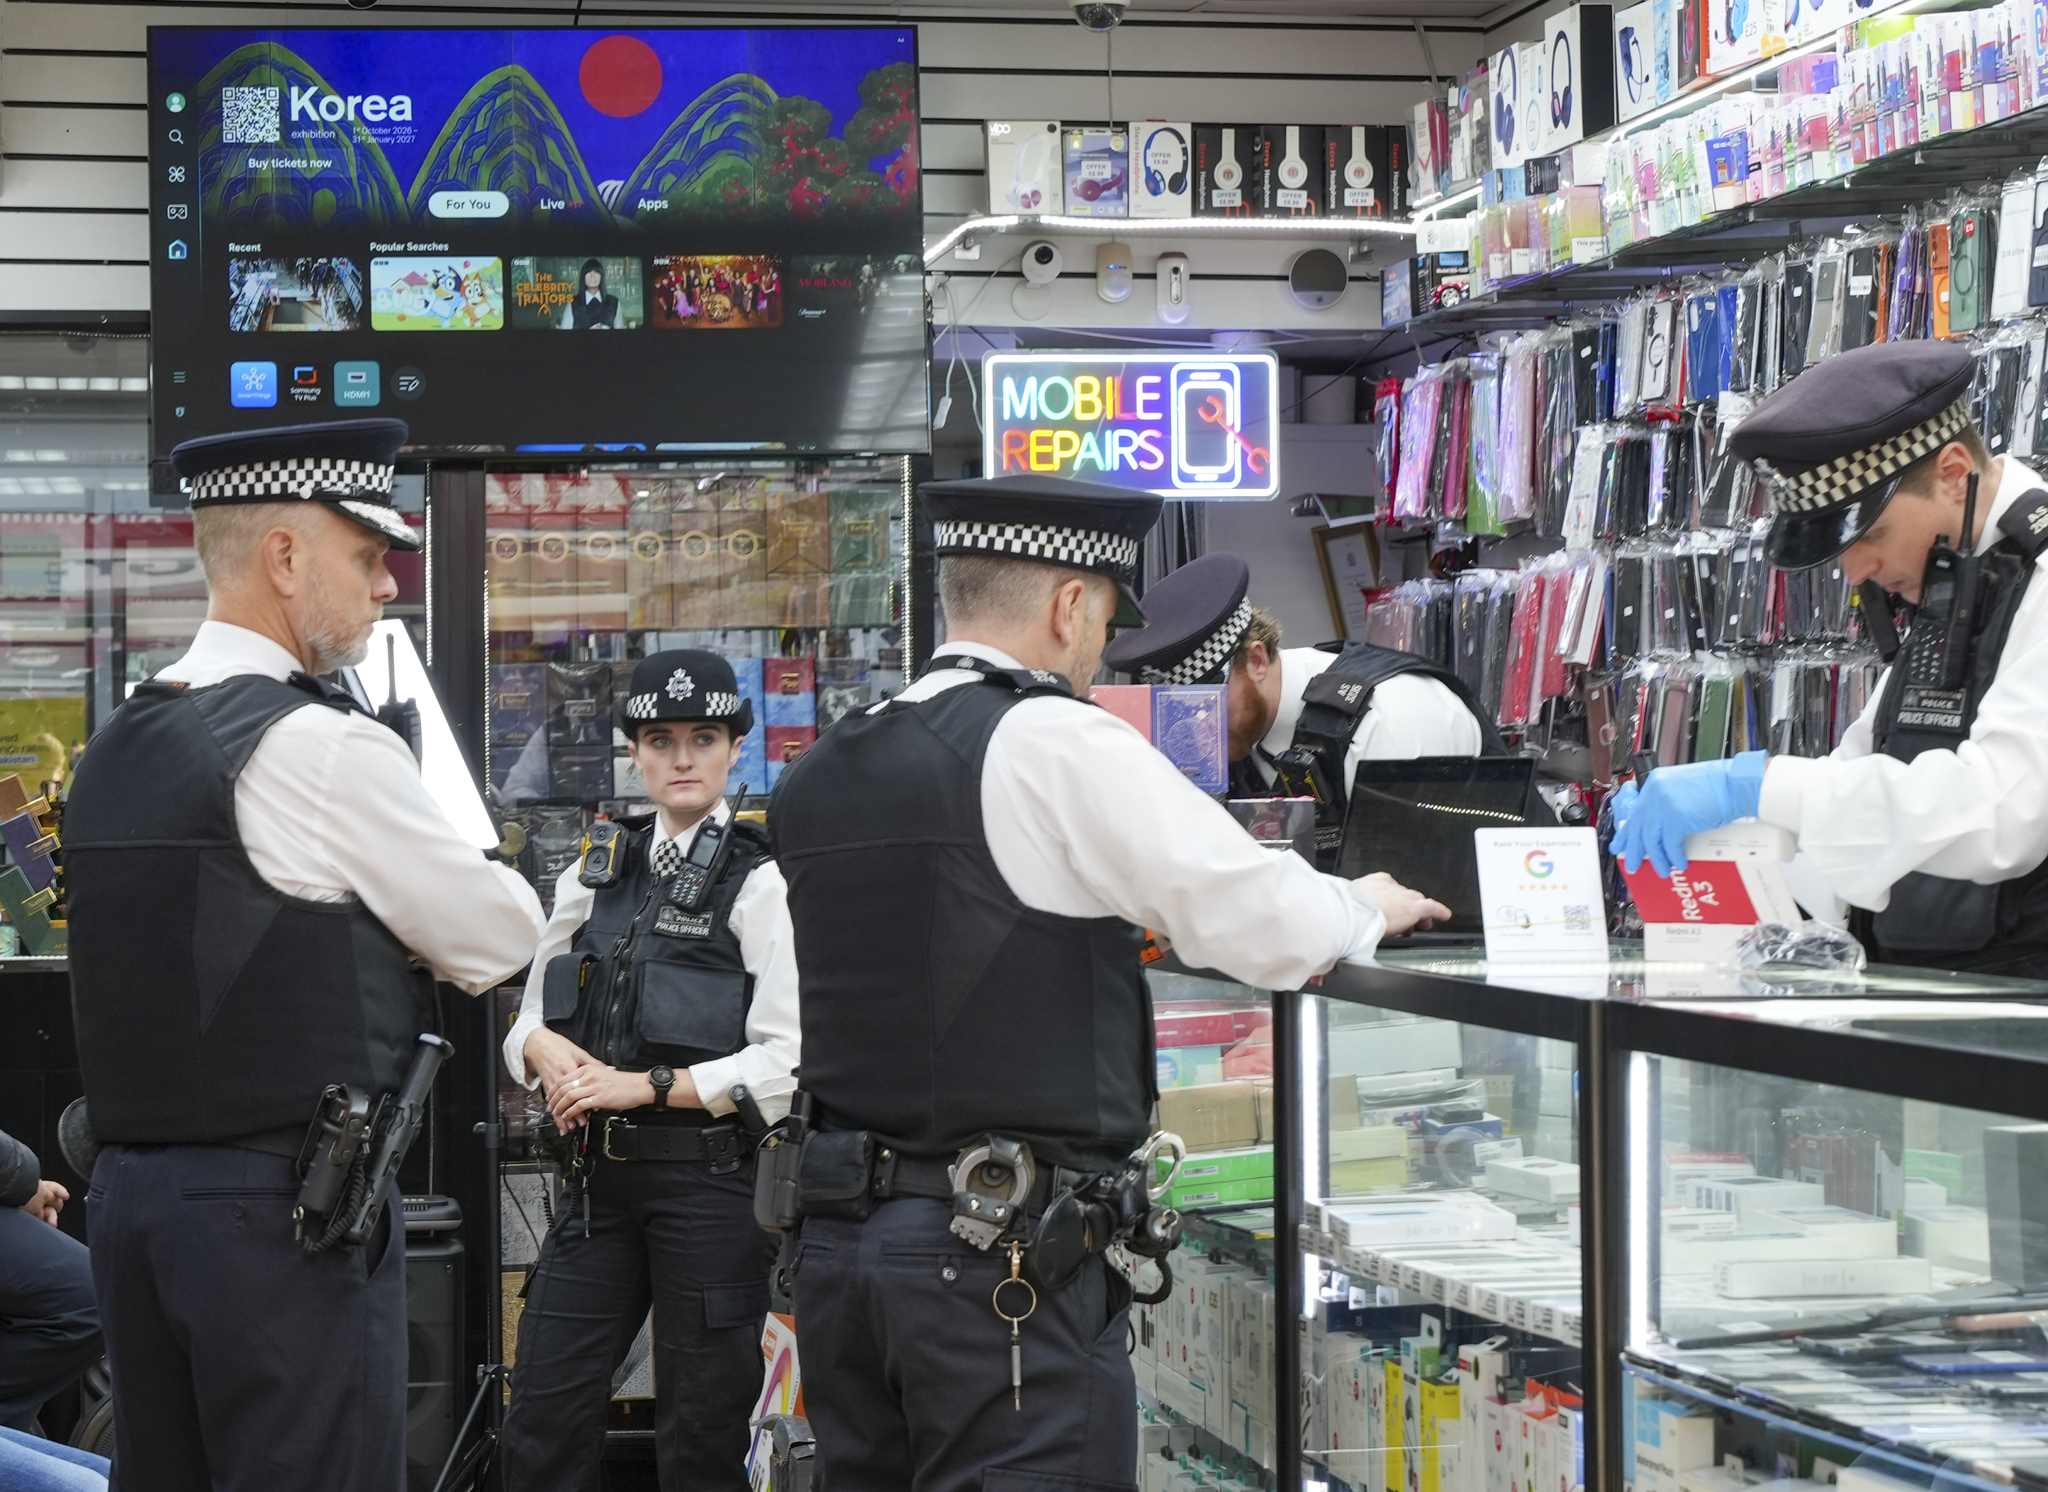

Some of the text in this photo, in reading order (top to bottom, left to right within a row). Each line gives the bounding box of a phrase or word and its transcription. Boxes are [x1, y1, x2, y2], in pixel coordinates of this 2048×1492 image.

[290, 86, 413, 122] Korea
[291, 129, 336, 139] exhibition
[361, 126, 391, 135] October
[392, 126, 412, 135] 2026
[367, 135, 396, 145] January
[396, 135, 416, 144] 2027
[248, 158, 332, 171] Buy tickets now
[446, 199, 491, 210] For You
[540, 198, 565, 210] Live
[638, 198, 668, 212] Apps
[229, 243, 261, 252] Recent
[370, 242, 449, 253] Popular Searches
[535, 272, 552, 282] THE
[516, 282, 574, 293] CELEBRITY
[799, 278, 852, 288] MOBLAND
[516, 292, 575, 307] TRAITORS
[290, 387, 321, 396] Samsung
[1002, 375, 1163, 421] MOBILE
[1002, 428, 1164, 472] REPAIRS
[1920, 699, 1955, 709] POLICE
[1897, 711, 1962, 728] POLICE OFFICER
[1536, 840, 1582, 848] Experience
[1525, 850, 1554, 879] G
[1692, 881, 1720, 906] A3
[676, 915, 704, 923] POLICE
[655, 921, 710, 936] POLICE OFFICER
[1666, 926, 1688, 935] Redmi
